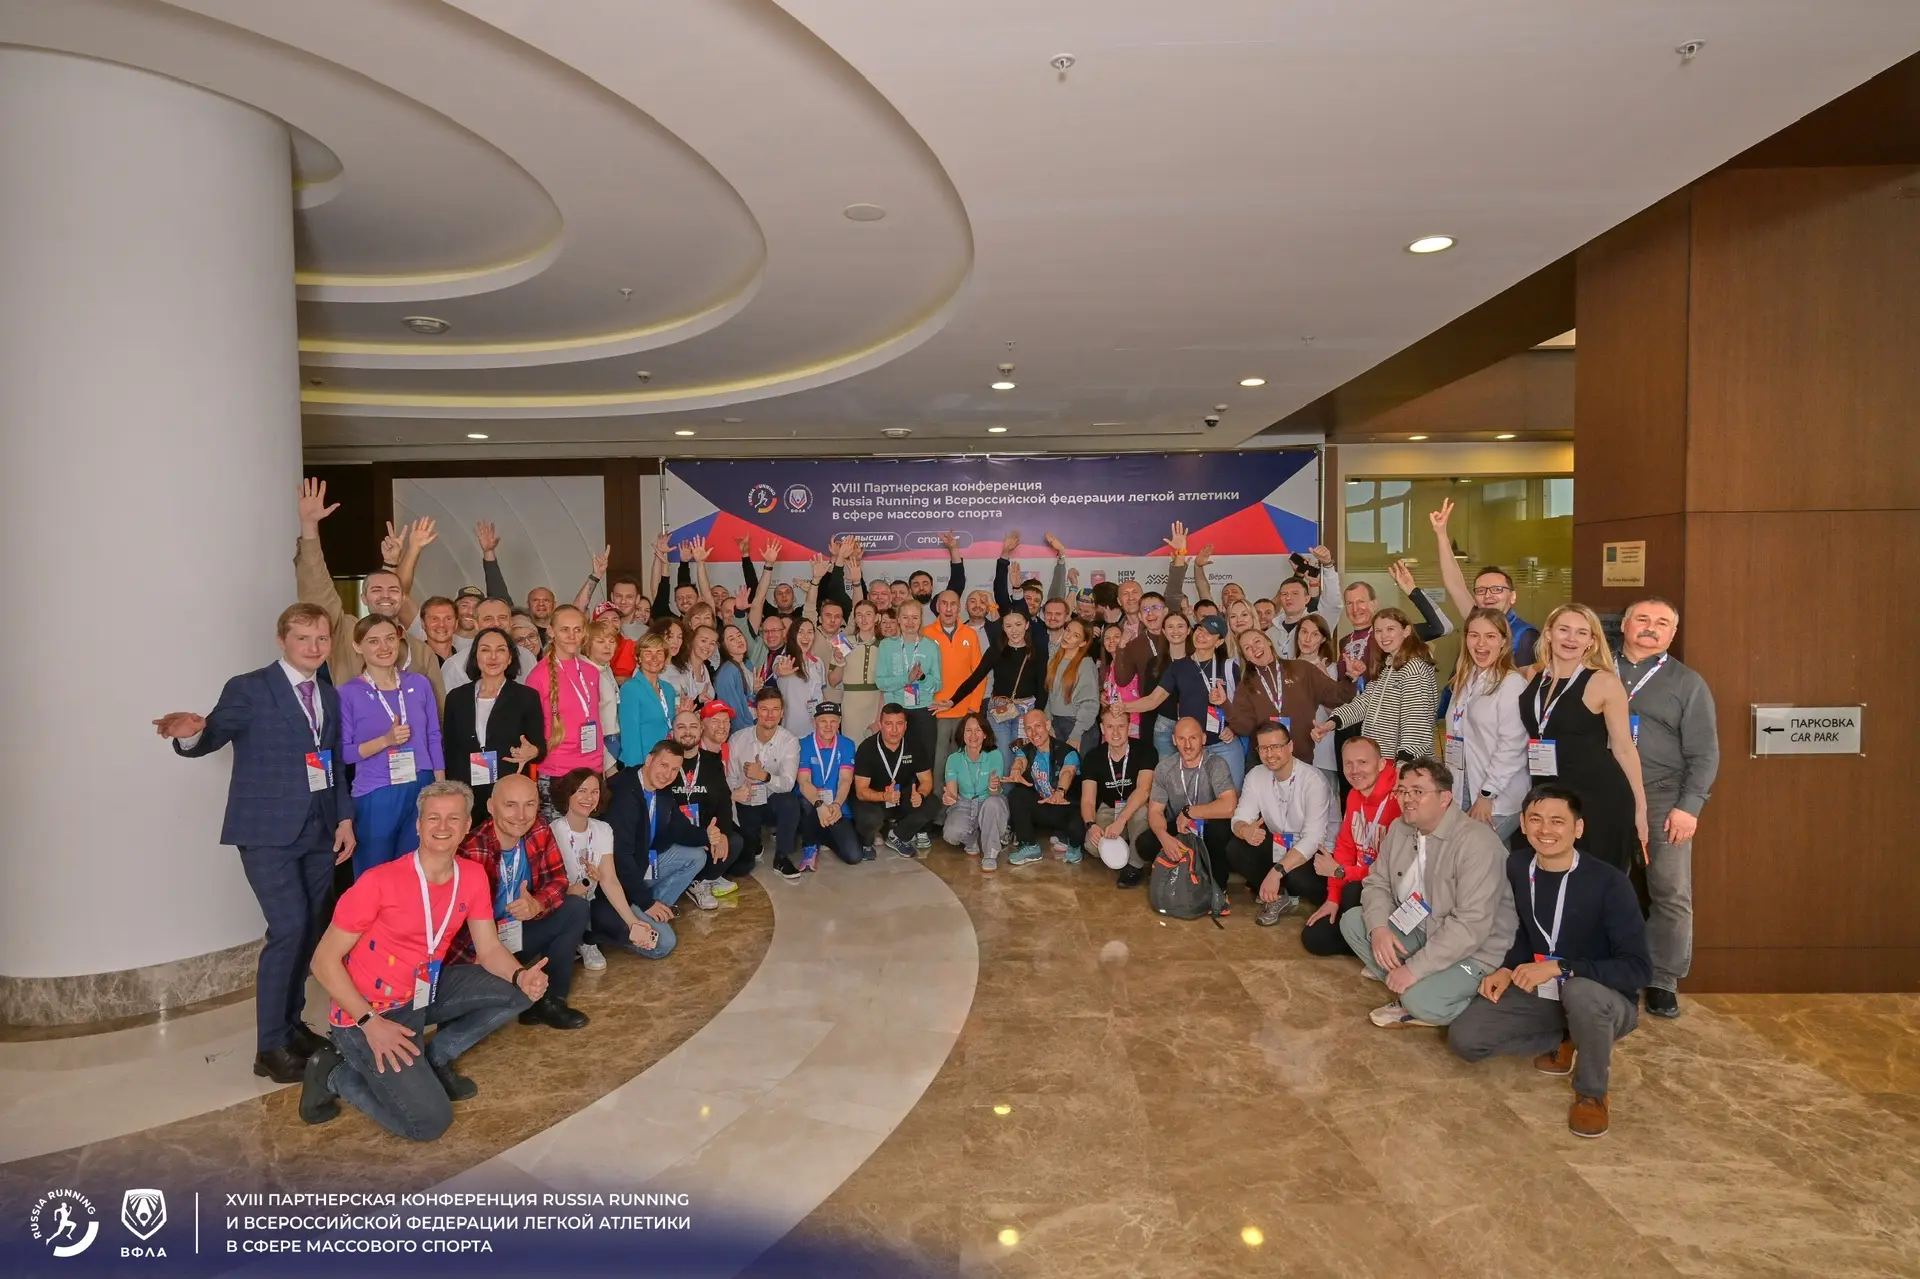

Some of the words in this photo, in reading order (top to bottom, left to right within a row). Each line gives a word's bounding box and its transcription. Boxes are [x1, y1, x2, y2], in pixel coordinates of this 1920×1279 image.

[832, 483, 860, 493] XVIII
[864, 482, 949, 495] Партнерская
[952, 481, 1042, 493] конференция
[832, 496, 873, 506] Russia
[876, 495, 929, 507] Running
[945, 493, 1046, 506] Всероссийской
[1050, 493, 1125, 505] федерации
[1128, 491, 1175, 502] легкой
[1178, 491, 1240, 501] атлетики
[843, 510, 883, 521] сфере
[887, 511, 955, 519] массового
[958, 509, 1003, 520] спорта
[917, 536, 944, 545] спор
[1791, 719, 1854, 728] ПАРКОВКА
[1791, 733, 1811, 742] CAR
[1814, 732, 1840, 742] PARK
